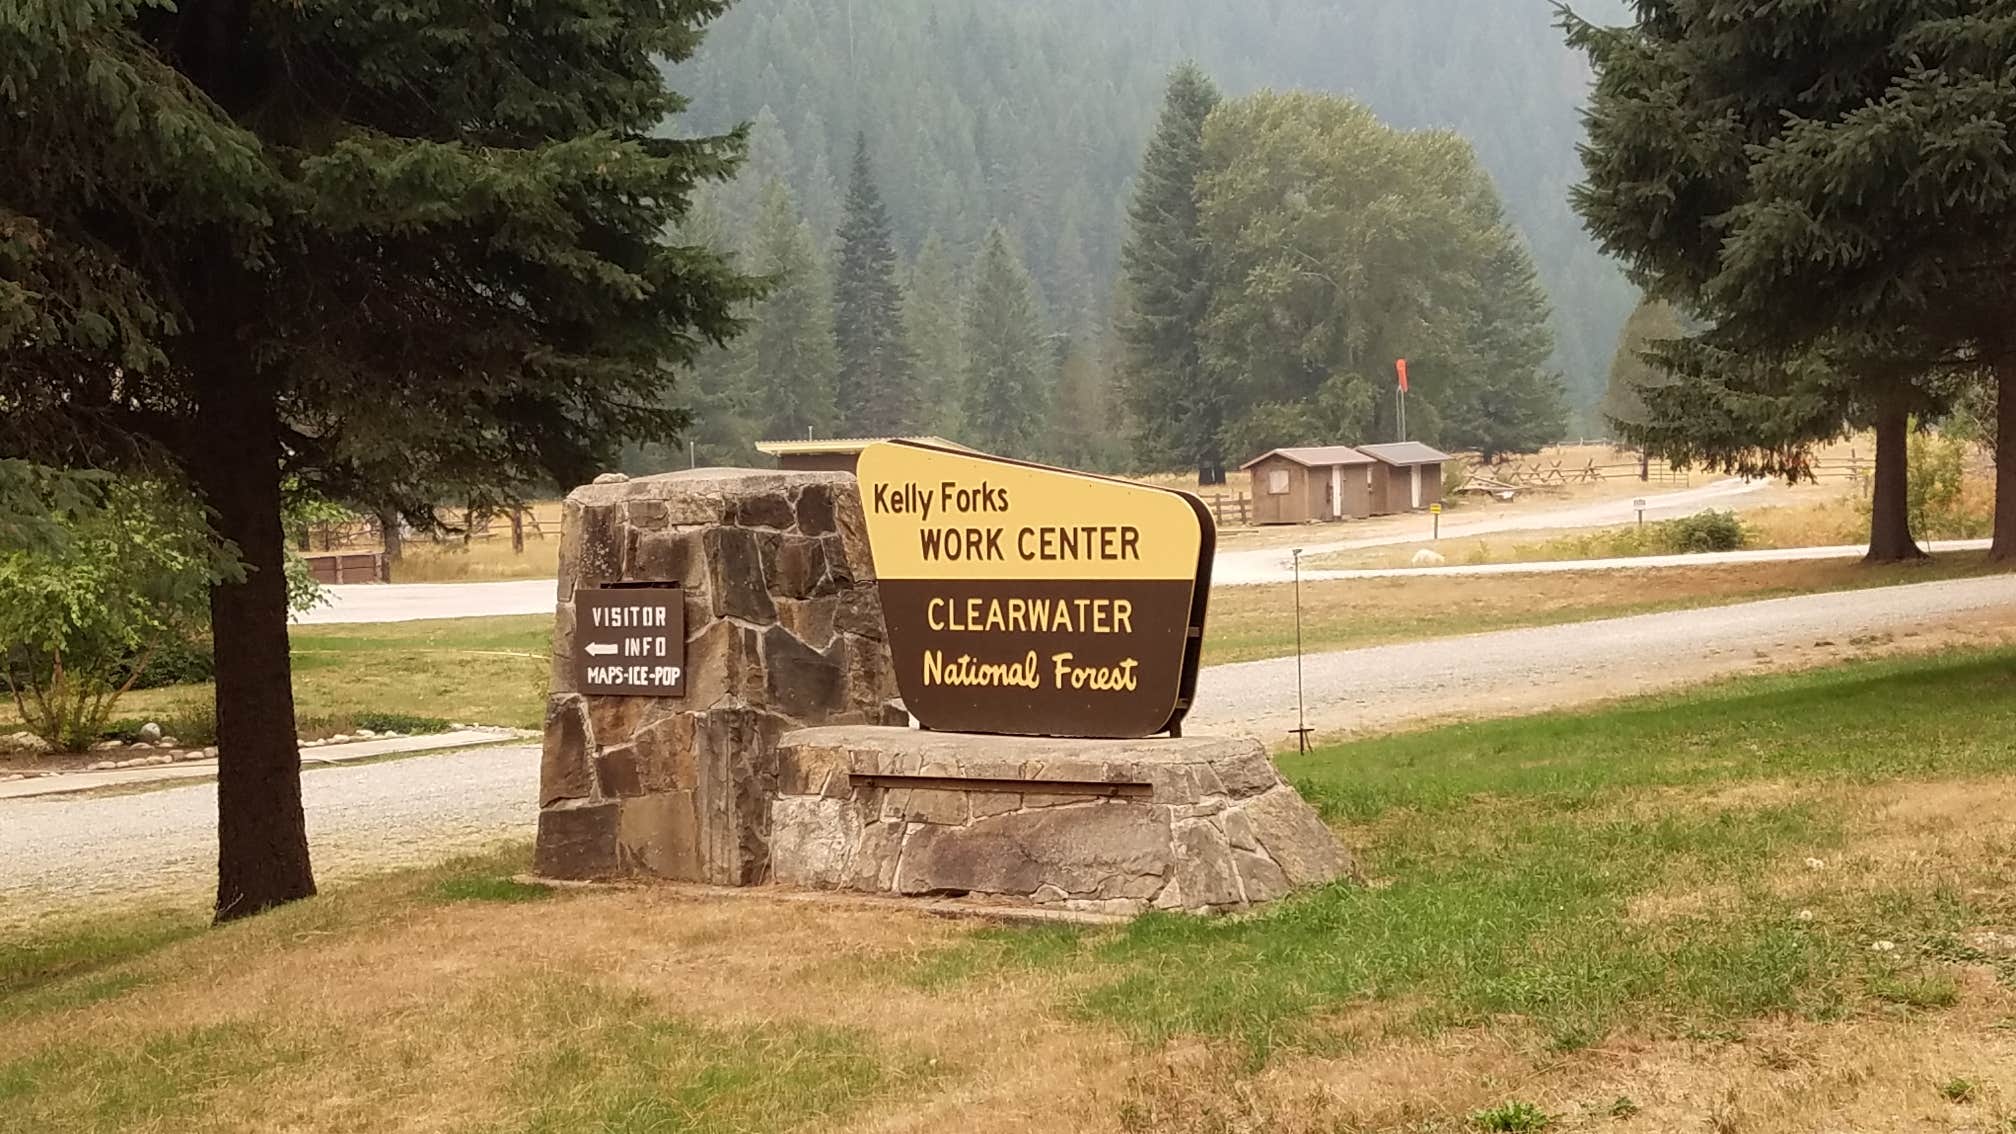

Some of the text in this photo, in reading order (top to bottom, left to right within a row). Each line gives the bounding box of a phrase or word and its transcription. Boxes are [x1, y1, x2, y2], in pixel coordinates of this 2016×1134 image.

[874, 480, 1009, 522] Kelly Forks
[919, 526, 1140, 561] WORK CENTER
[592, 606, 666, 627] VISITOR
[927, 597, 1132, 633] CLEARWATER
[624, 636, 666, 657] INFO
[587, 665, 681, 686] MAPS-ICE-POP
[923, 650, 1139, 691] National Forest
